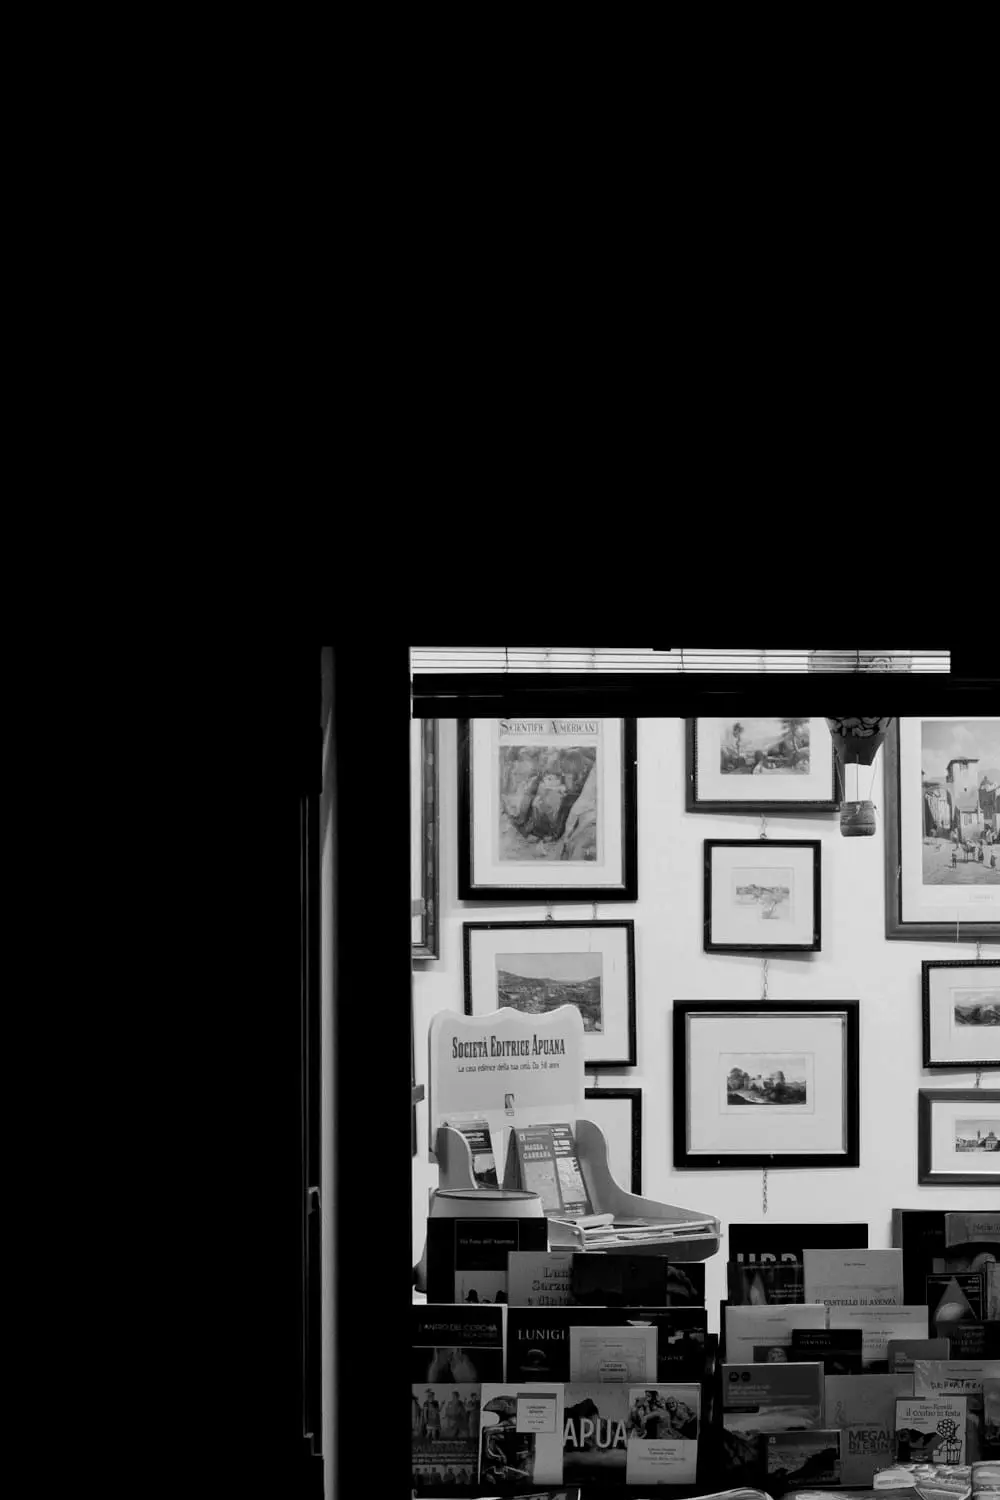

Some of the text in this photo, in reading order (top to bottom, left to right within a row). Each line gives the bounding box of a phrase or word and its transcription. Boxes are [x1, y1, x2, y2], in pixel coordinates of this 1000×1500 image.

[552, 720, 596, 734] AMERICAN
[490, 1035, 530, 1057] EDITRICE
[532, 1034, 566, 1056] APUANA
[477, 1063, 496, 1072] editrice
[522, 1151, 552, 1160] CARRARA
[824, 1298, 859, 1306] CASTELLO
[518, 1328, 566, 1341] LUNIGI
